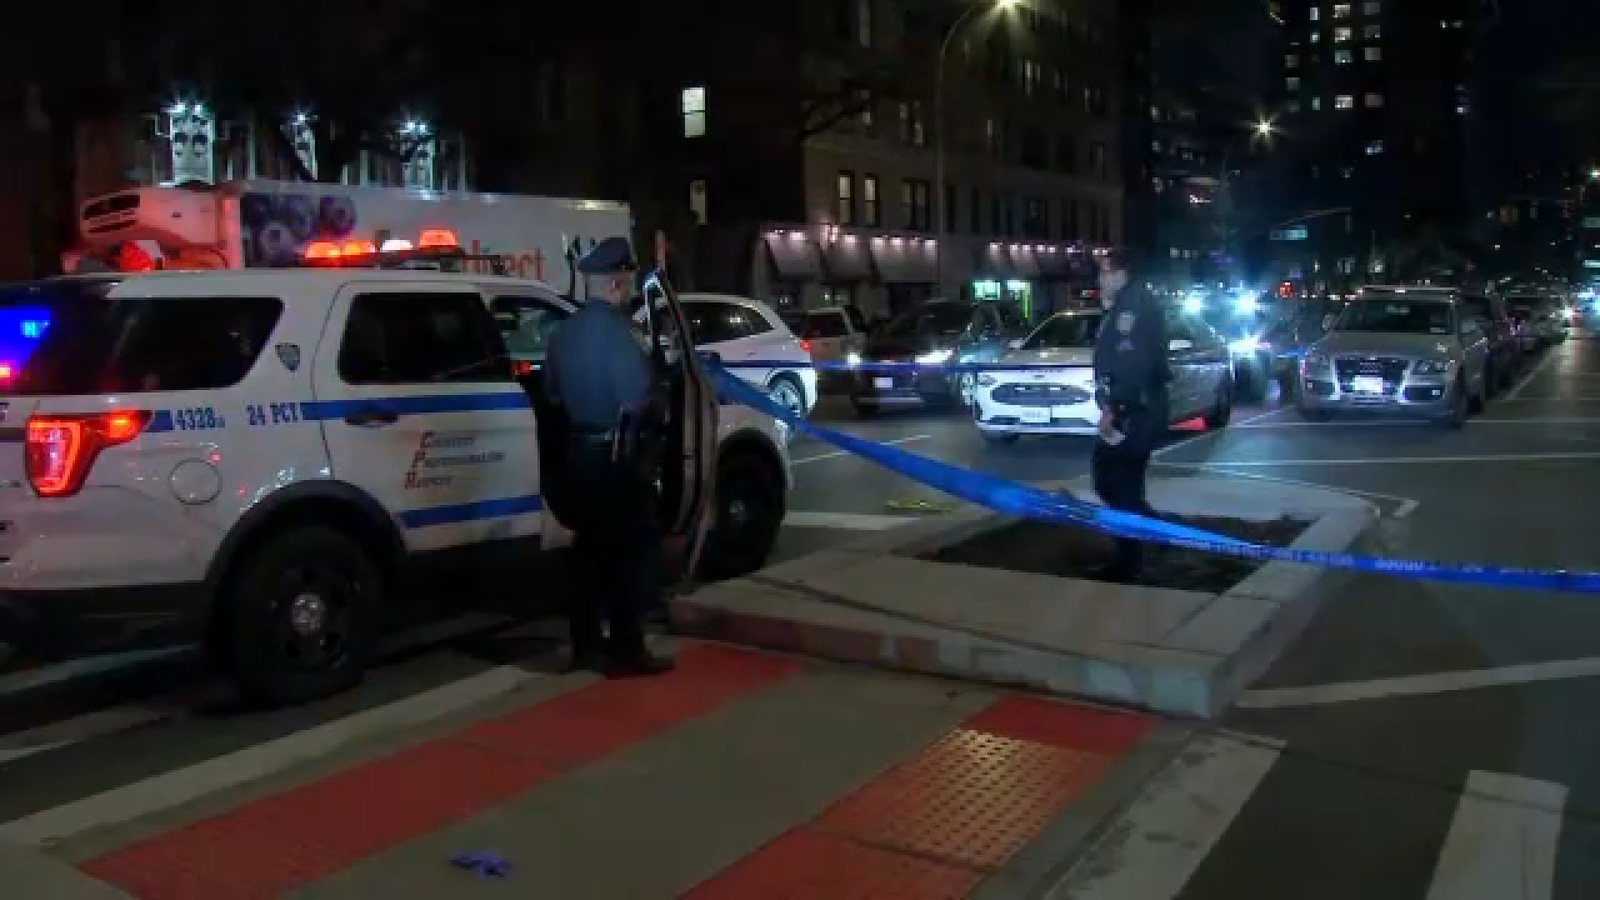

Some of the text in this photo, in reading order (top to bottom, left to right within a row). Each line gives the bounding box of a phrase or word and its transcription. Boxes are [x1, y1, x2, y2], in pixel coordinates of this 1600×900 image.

[175, 406, 216, 431] 4328
[245, 404, 266, 426] 24
[269, 402, 299, 425] PCT
